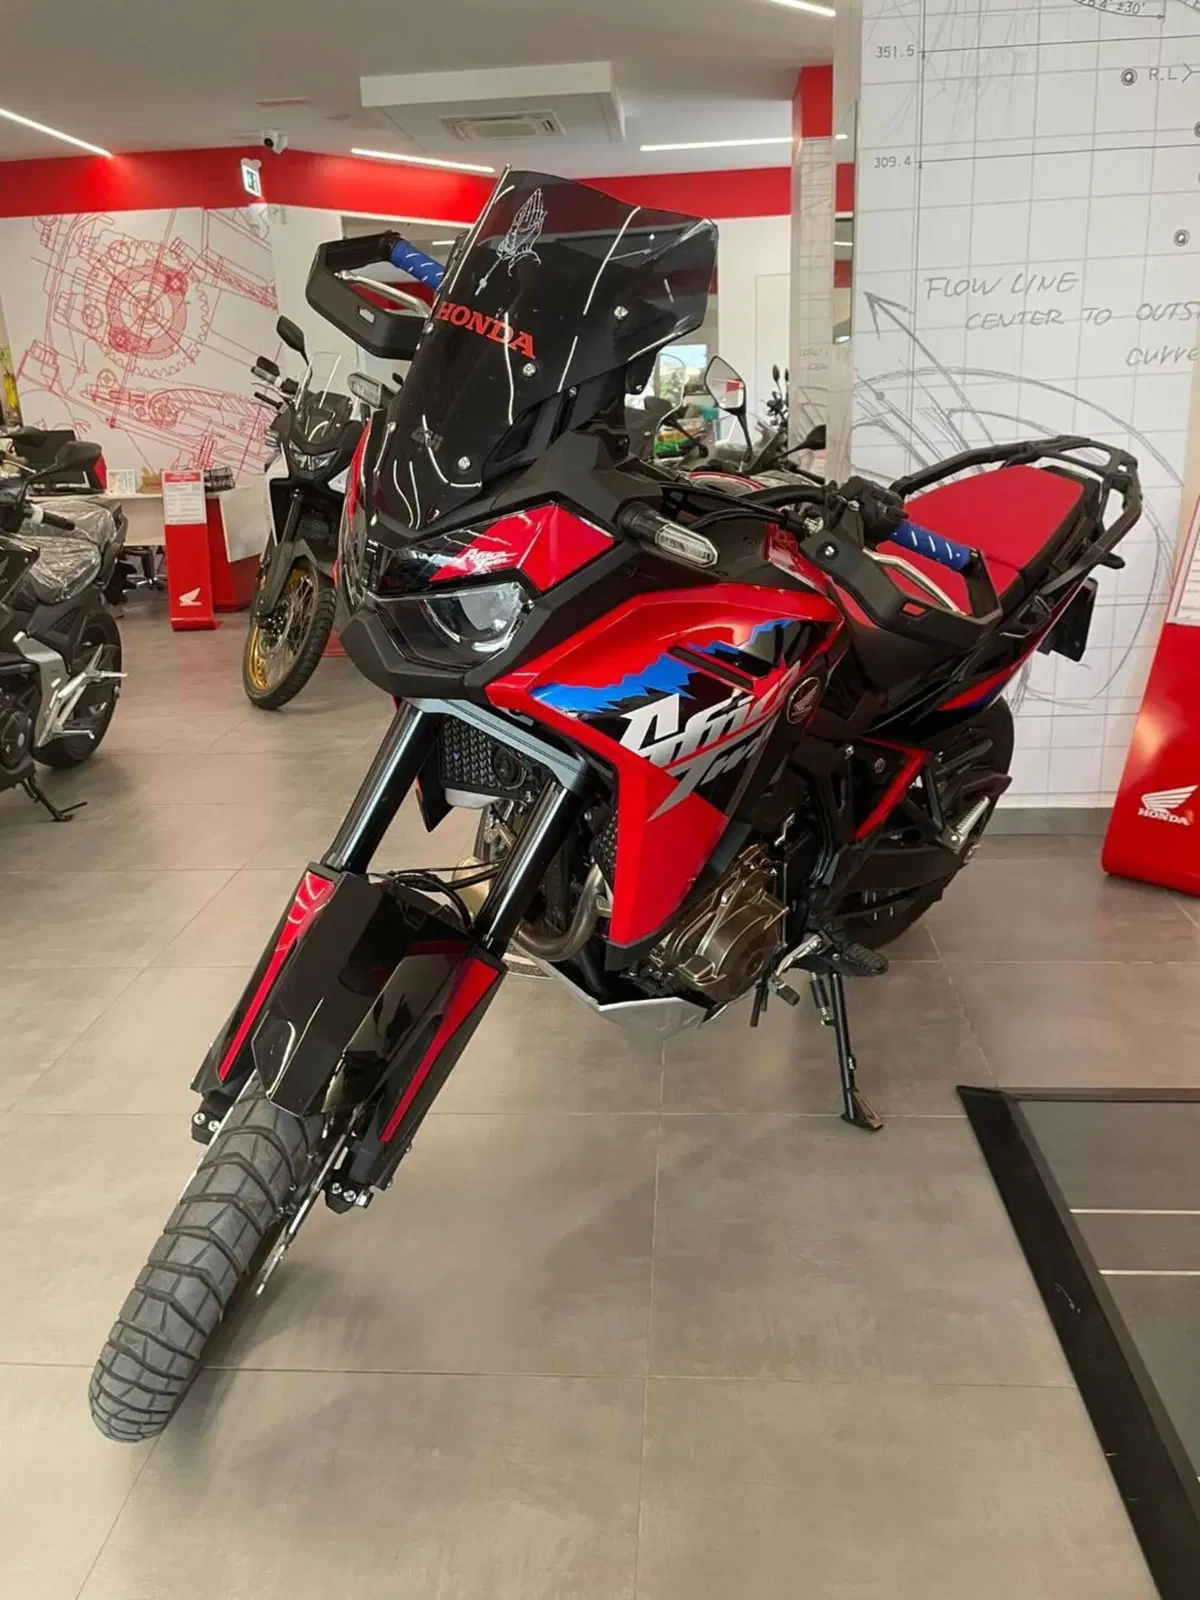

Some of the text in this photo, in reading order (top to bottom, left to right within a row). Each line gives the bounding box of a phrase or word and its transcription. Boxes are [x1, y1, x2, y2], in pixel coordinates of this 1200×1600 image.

[875, 44, 915, 59] 351.5
[873, 155, 912, 169] 309.4
[923, 271, 1079, 301] FLOW LINE
[965, 301, 1200, 331] CENTER TO OUTS
[436, 300, 537, 360] HONDA
[1137, 807, 1190, 826] HONDA
